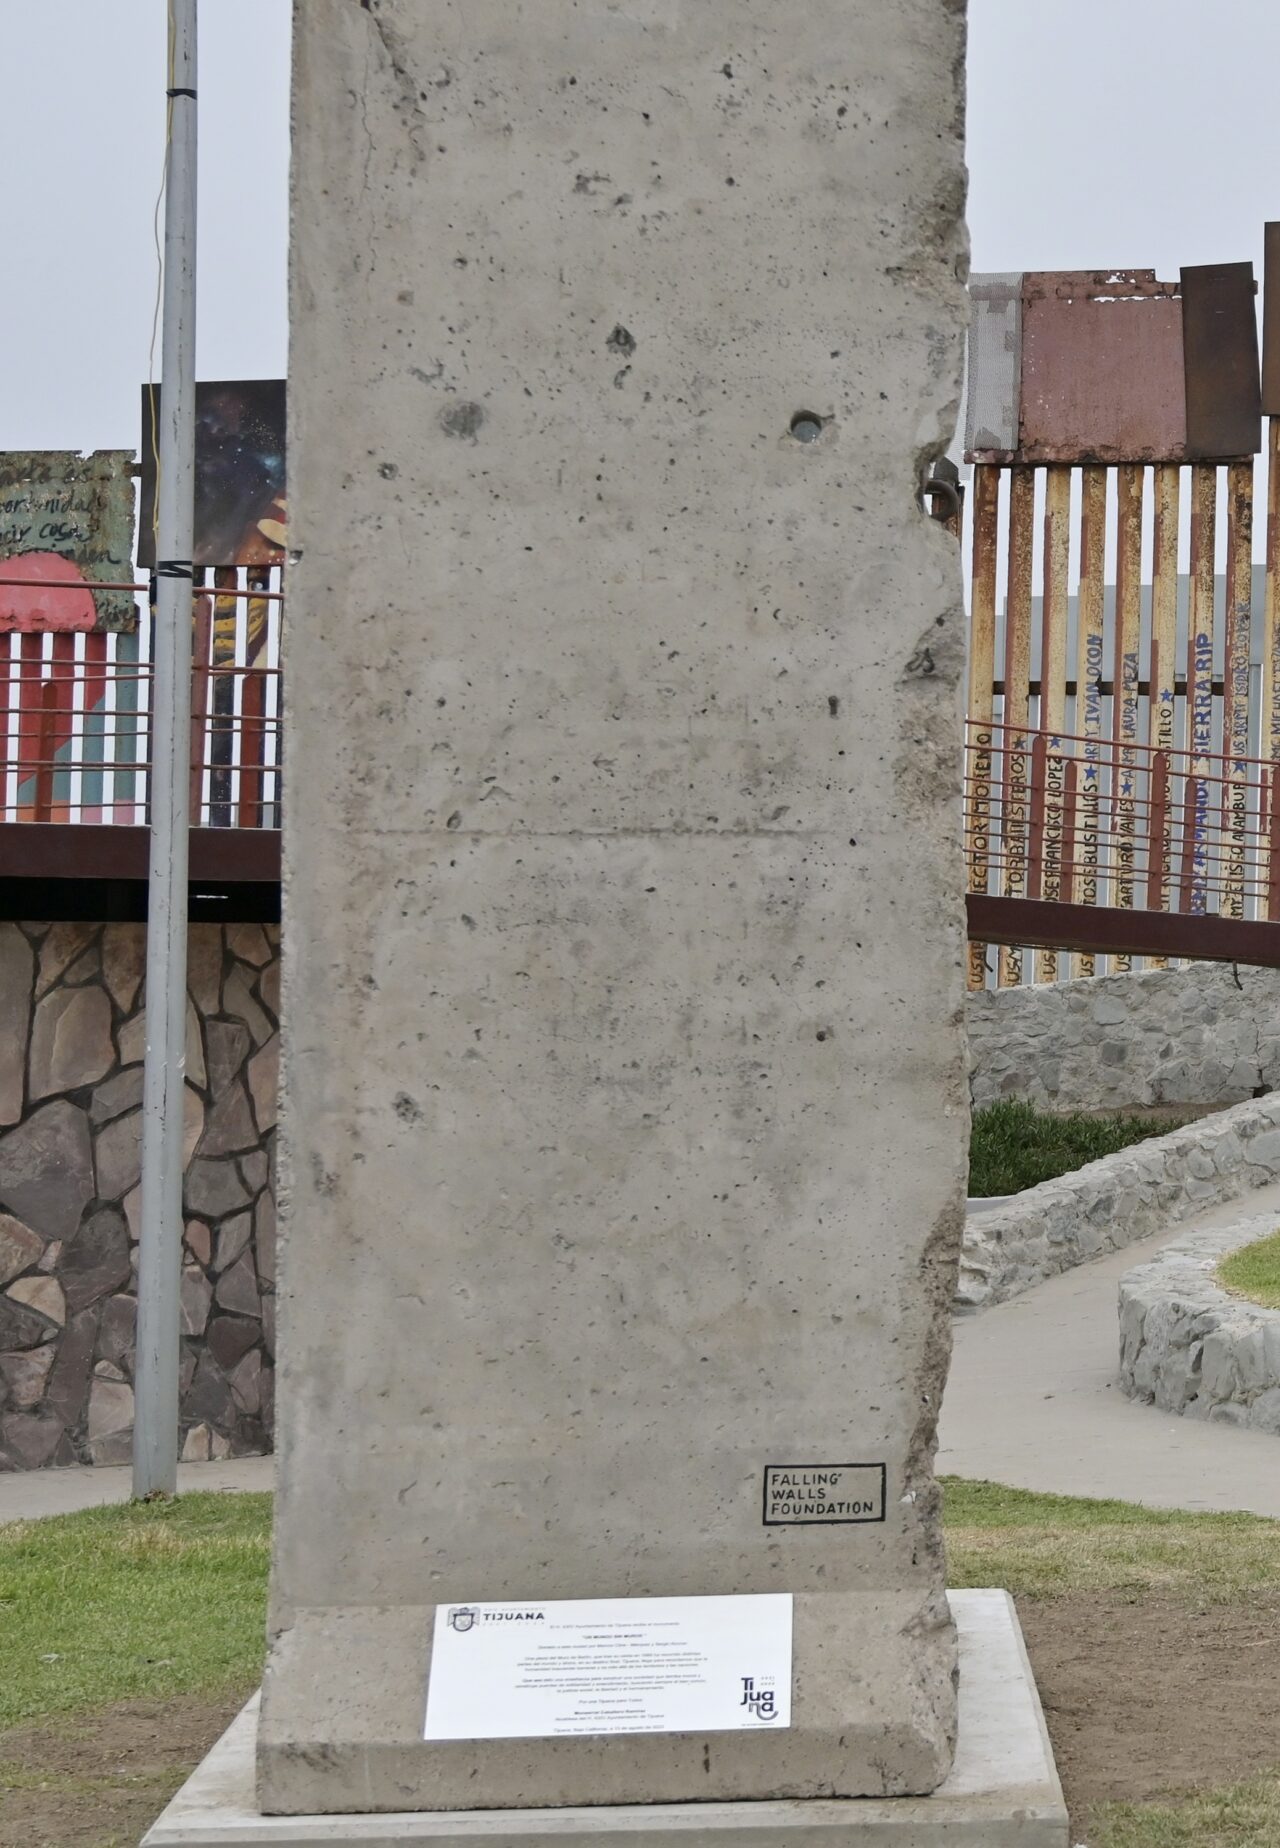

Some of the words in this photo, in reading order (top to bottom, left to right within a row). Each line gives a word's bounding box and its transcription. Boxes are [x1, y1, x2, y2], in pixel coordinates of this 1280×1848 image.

[1195, 633, 1213, 672] RIP
[1121, 698, 1135, 738] LAURA
[1194, 678, 1211, 761] SIERRA
[772, 1473, 840, 1486] FALLING
[772, 1488, 827, 1500] WALLS
[771, 1502, 874, 1515] FOUNDATION
[483, 1612, 546, 1621] TIJUANA
